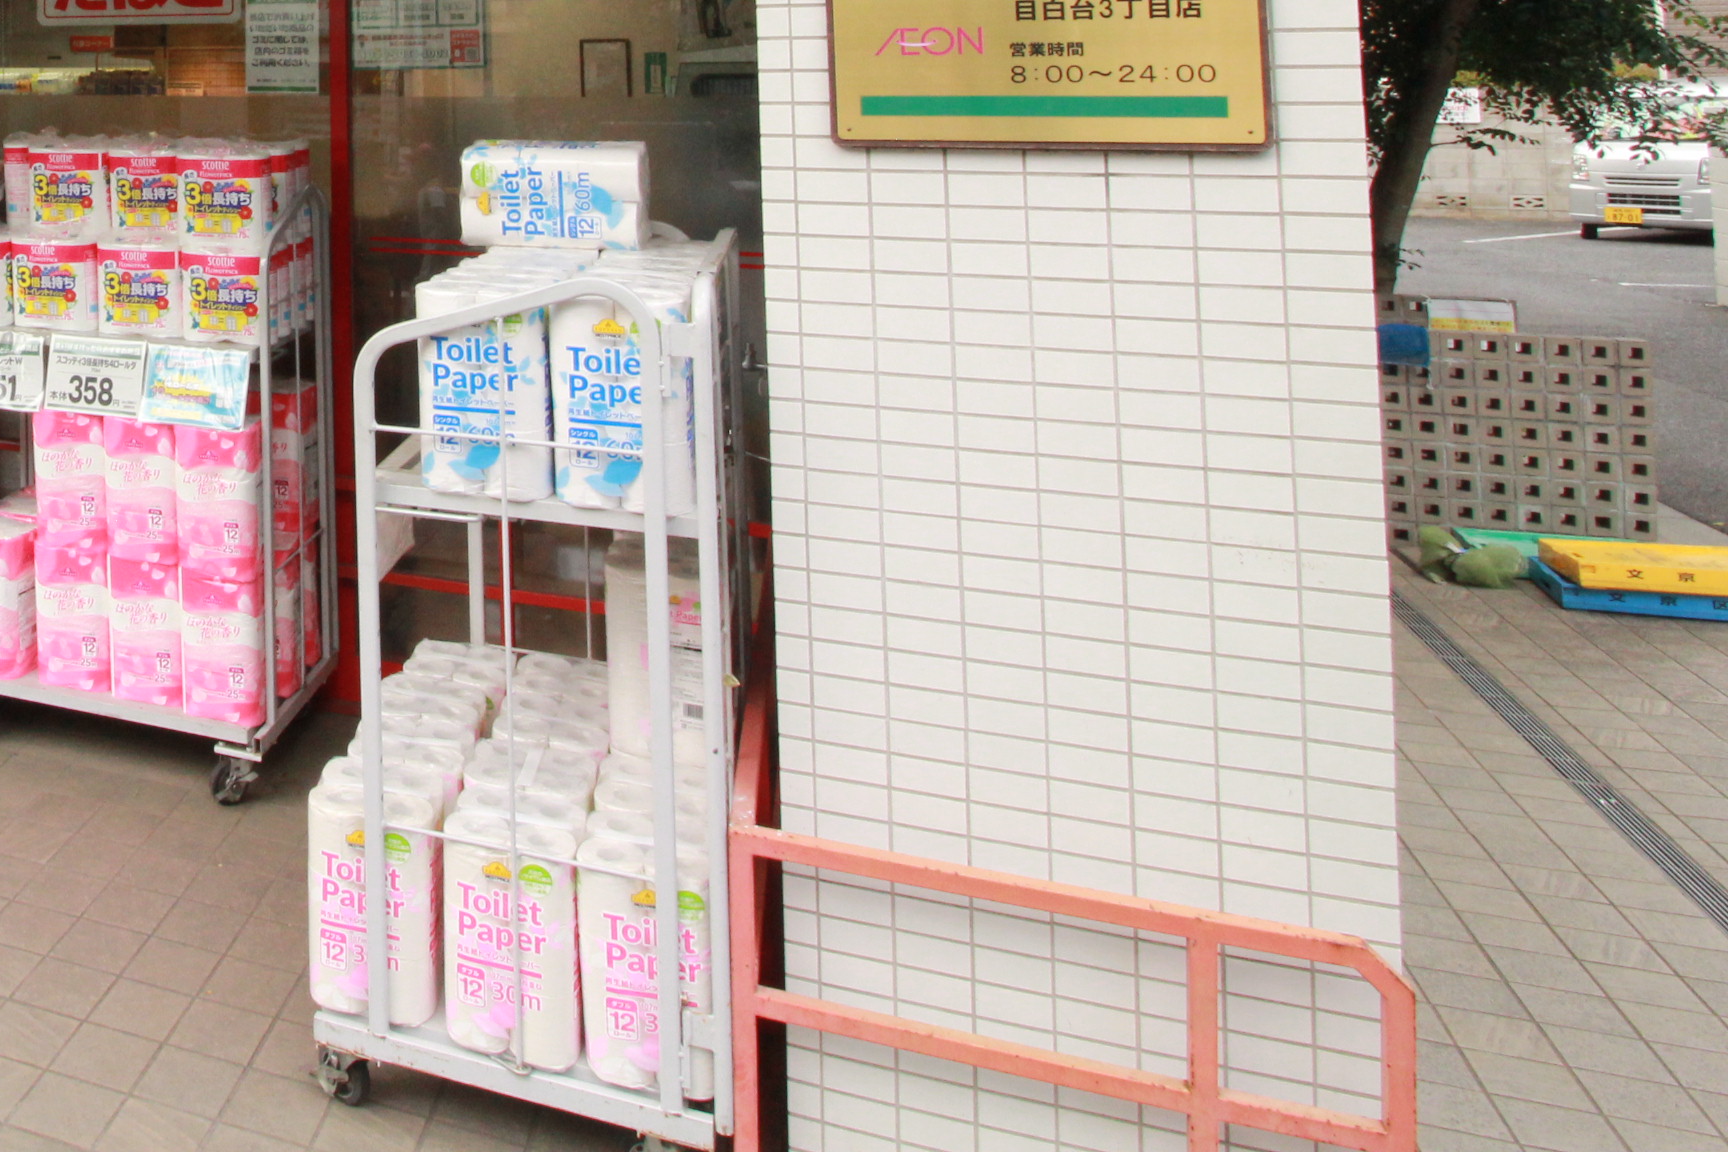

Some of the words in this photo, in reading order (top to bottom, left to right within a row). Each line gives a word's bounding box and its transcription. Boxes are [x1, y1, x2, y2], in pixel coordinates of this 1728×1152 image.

[1009, 41, 1085, 58] 営業時間
[575, 172, 590, 212] 60m
[500, 169, 522, 236] Toilet
[524, 166, 549, 236] Paper
[578, 218, 594, 235] 12
[430, 335, 513, 364] Toilet
[566, 346, 640, 376] Toile
[50, 391, 68, 400] 本体
[69, 375, 114, 407] 358
[568, 374, 641, 408] Pape
[55, 457, 92, 472] 花の香り
[123, 468, 161, 483] 花の香り
[197, 482, 238, 496] 花の香り
[276, 485, 288, 496] 12
[82, 502, 94, 513] 12
[150, 516, 162, 526] 12
[225, 529, 238, 540] 12
[57, 598, 95, 610] 花の香り
[129, 612, 167, 625] 花の香り
[200, 626, 241, 639] 花の香り
[84, 642, 95, 653] 12
[158, 658, 170, 669] 12
[231, 673, 244, 685] 12
[321, 850, 401, 892] Toit
[458, 910, 547, 955] Paper
[323, 941, 344, 963] 12
[460, 977, 483, 1000] 12
[609, 1011, 636, 1033] 12
